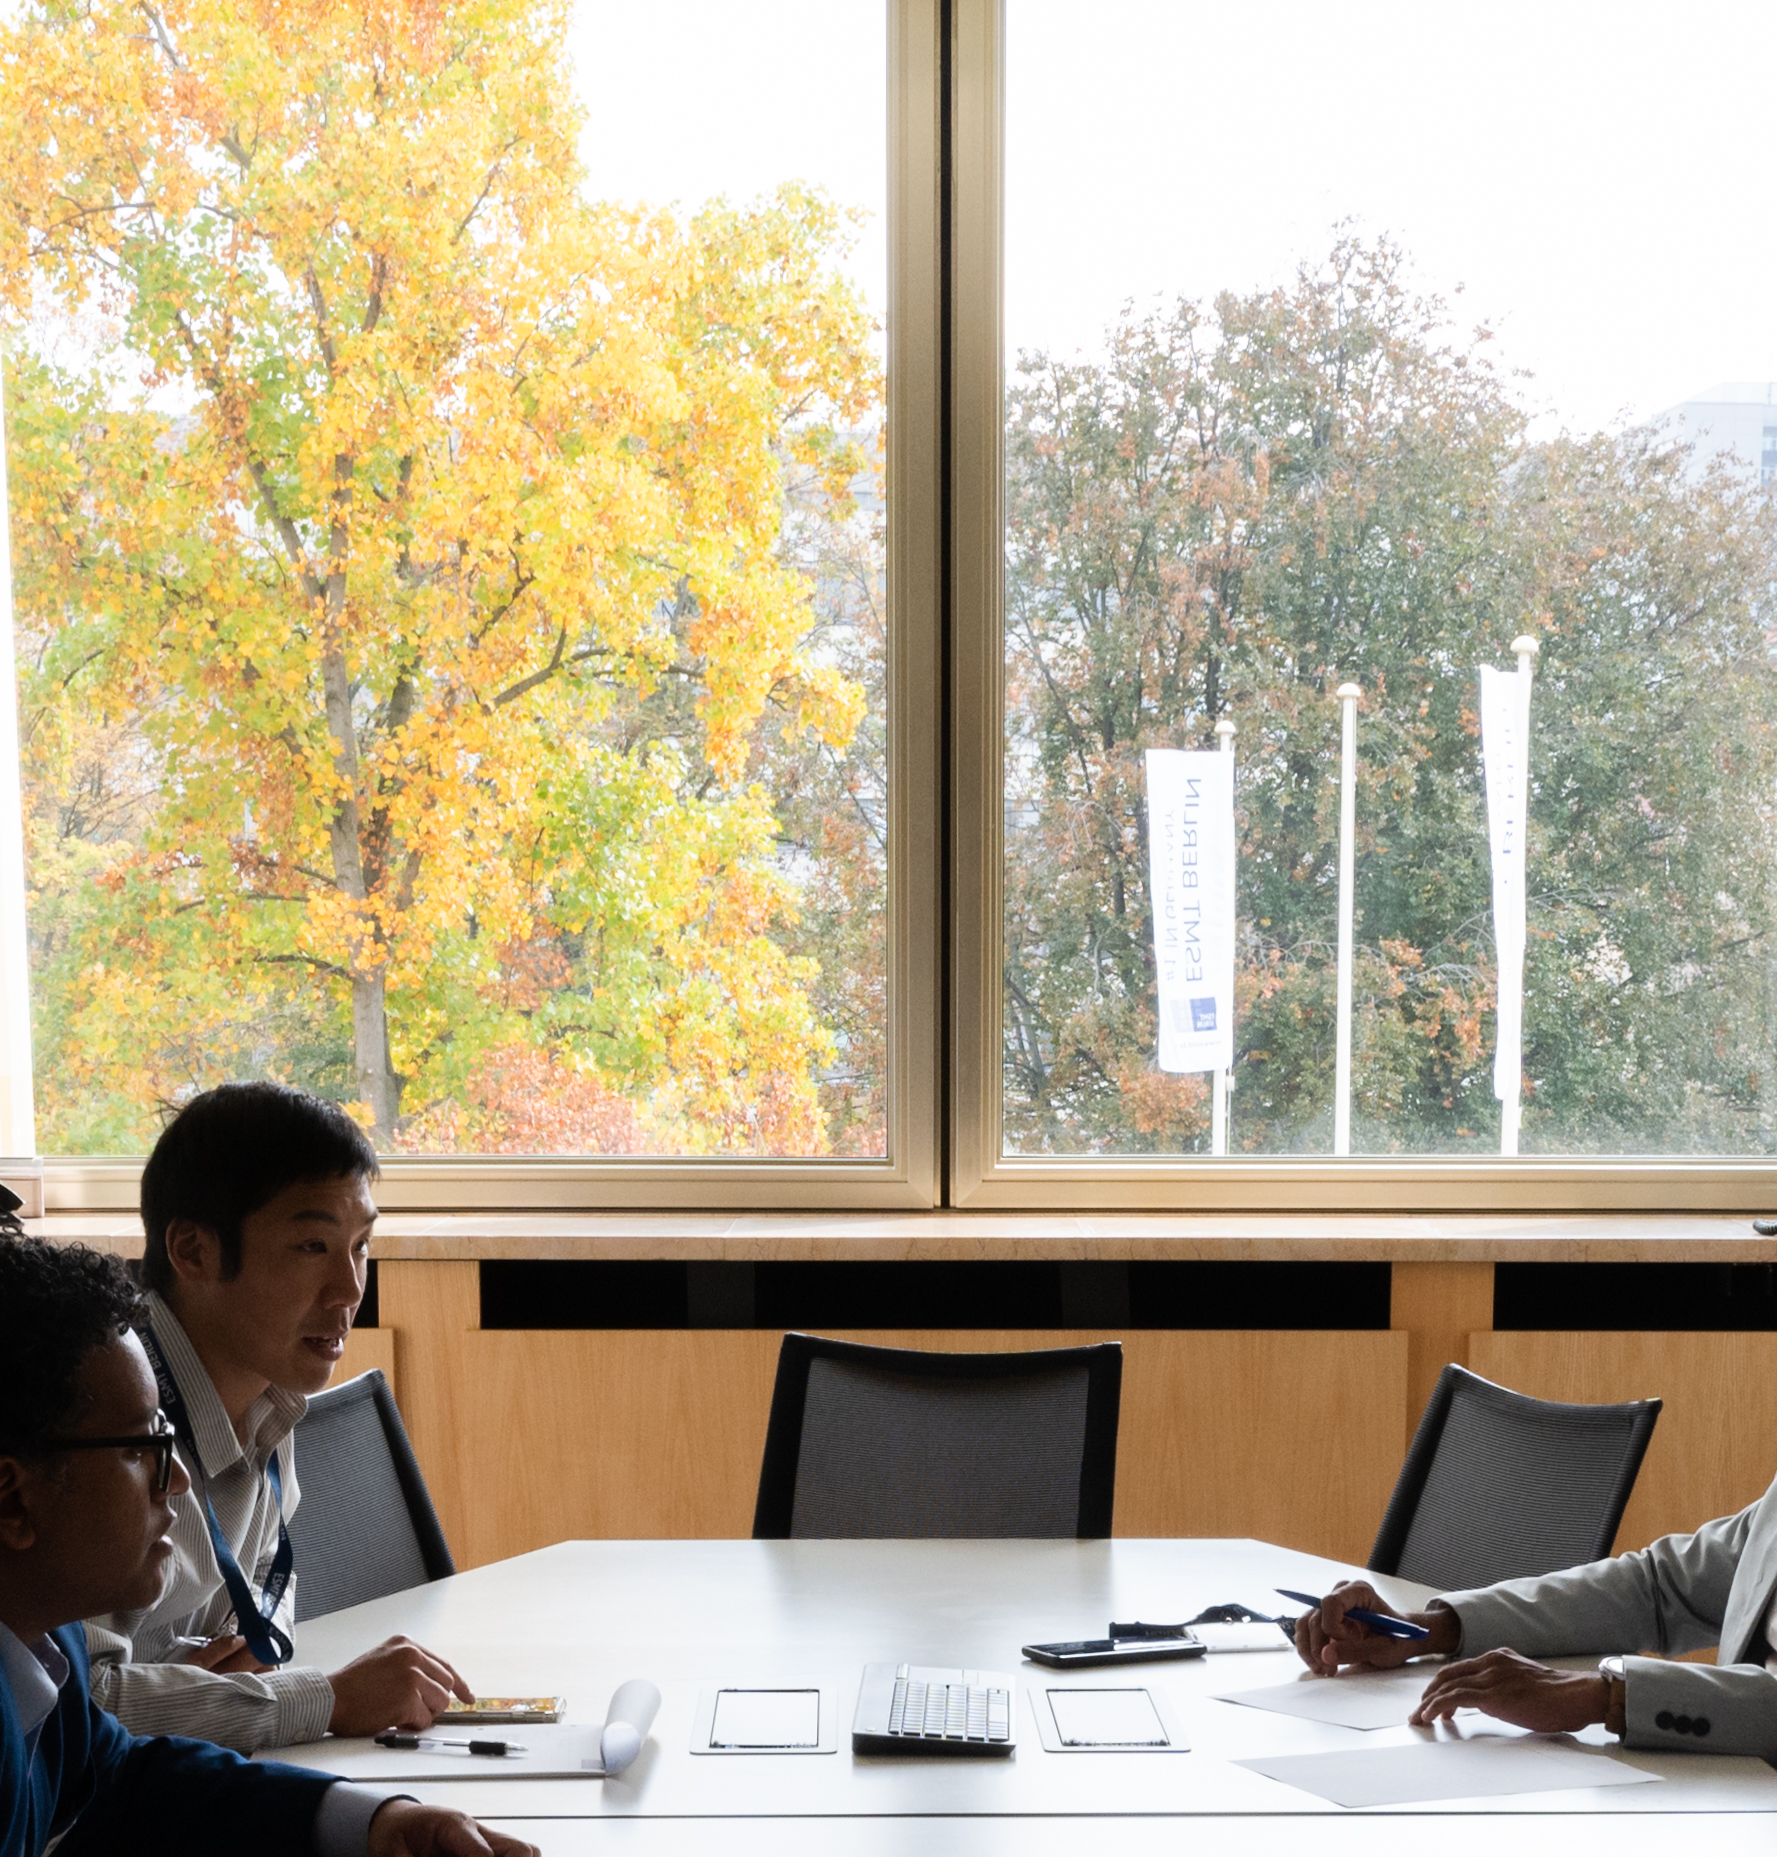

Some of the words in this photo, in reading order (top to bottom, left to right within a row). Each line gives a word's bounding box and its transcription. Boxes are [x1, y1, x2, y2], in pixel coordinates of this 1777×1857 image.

[140, 1332, 161, 1371] BERLIN
[157, 1372, 176, 1404] ESMT
[270, 1572, 285, 1596] ESMT
